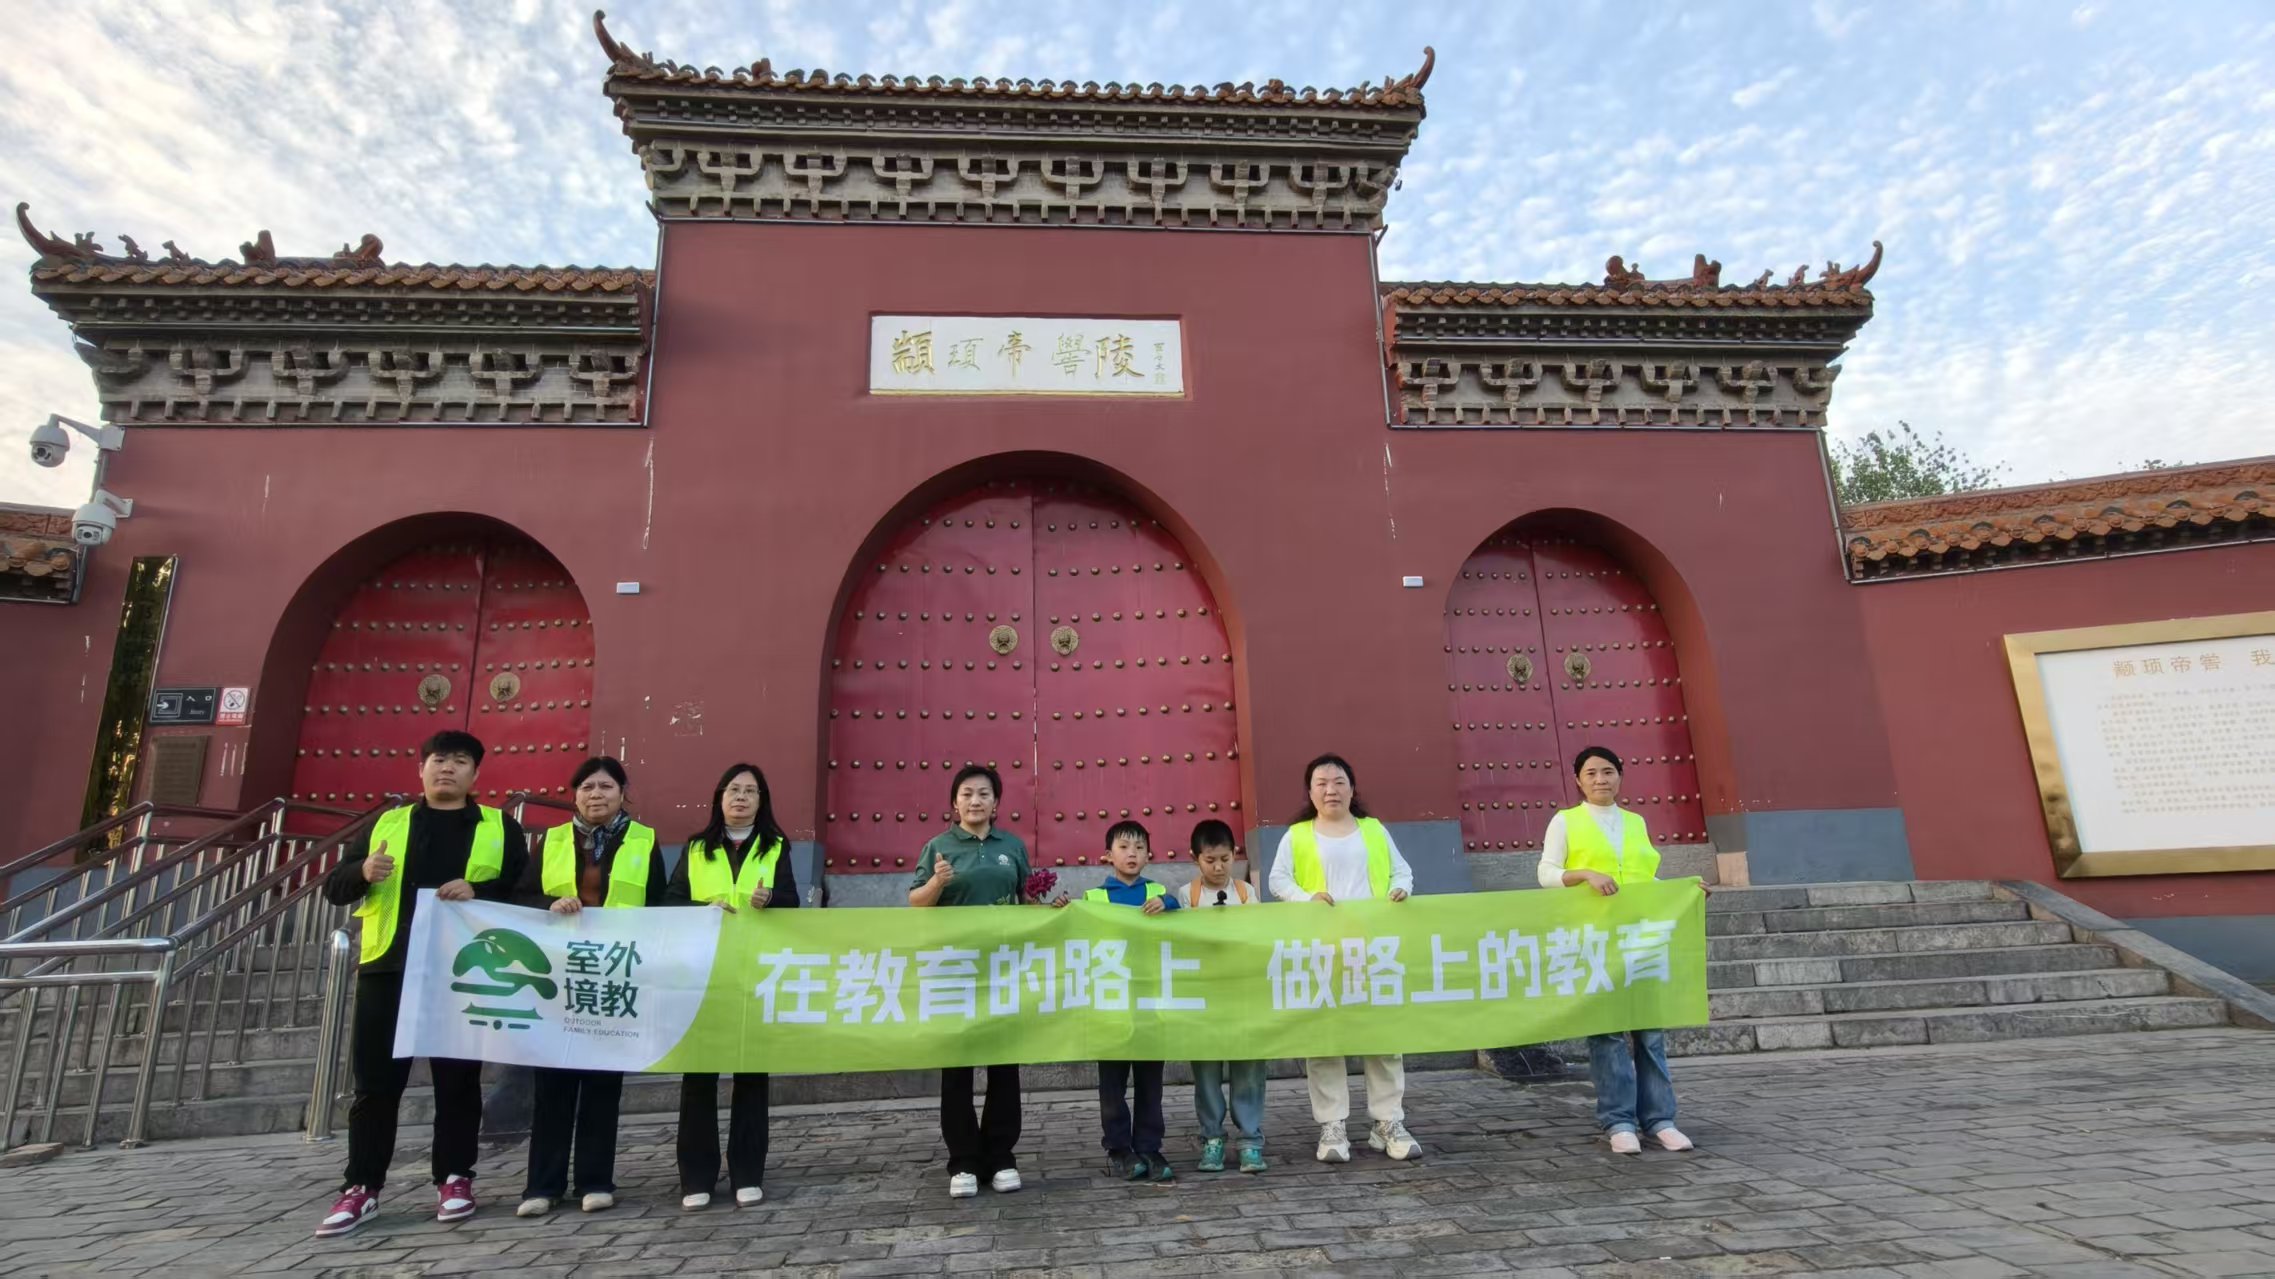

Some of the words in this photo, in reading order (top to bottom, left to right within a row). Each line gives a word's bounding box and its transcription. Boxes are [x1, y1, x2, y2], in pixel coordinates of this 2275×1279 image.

[2112, 652, 2222, 679] 颛顼帝喾
[565, 940, 643, 978] 室外
[755, 939, 1206, 1024] 在教育的路上
[1267, 918, 1676, 1010] 做路上的教育
[564, 977, 639, 1019] 境教
[563, 1026, 591, 1035] FAMILY
[594, 1029, 639, 1038] EDUCATION
